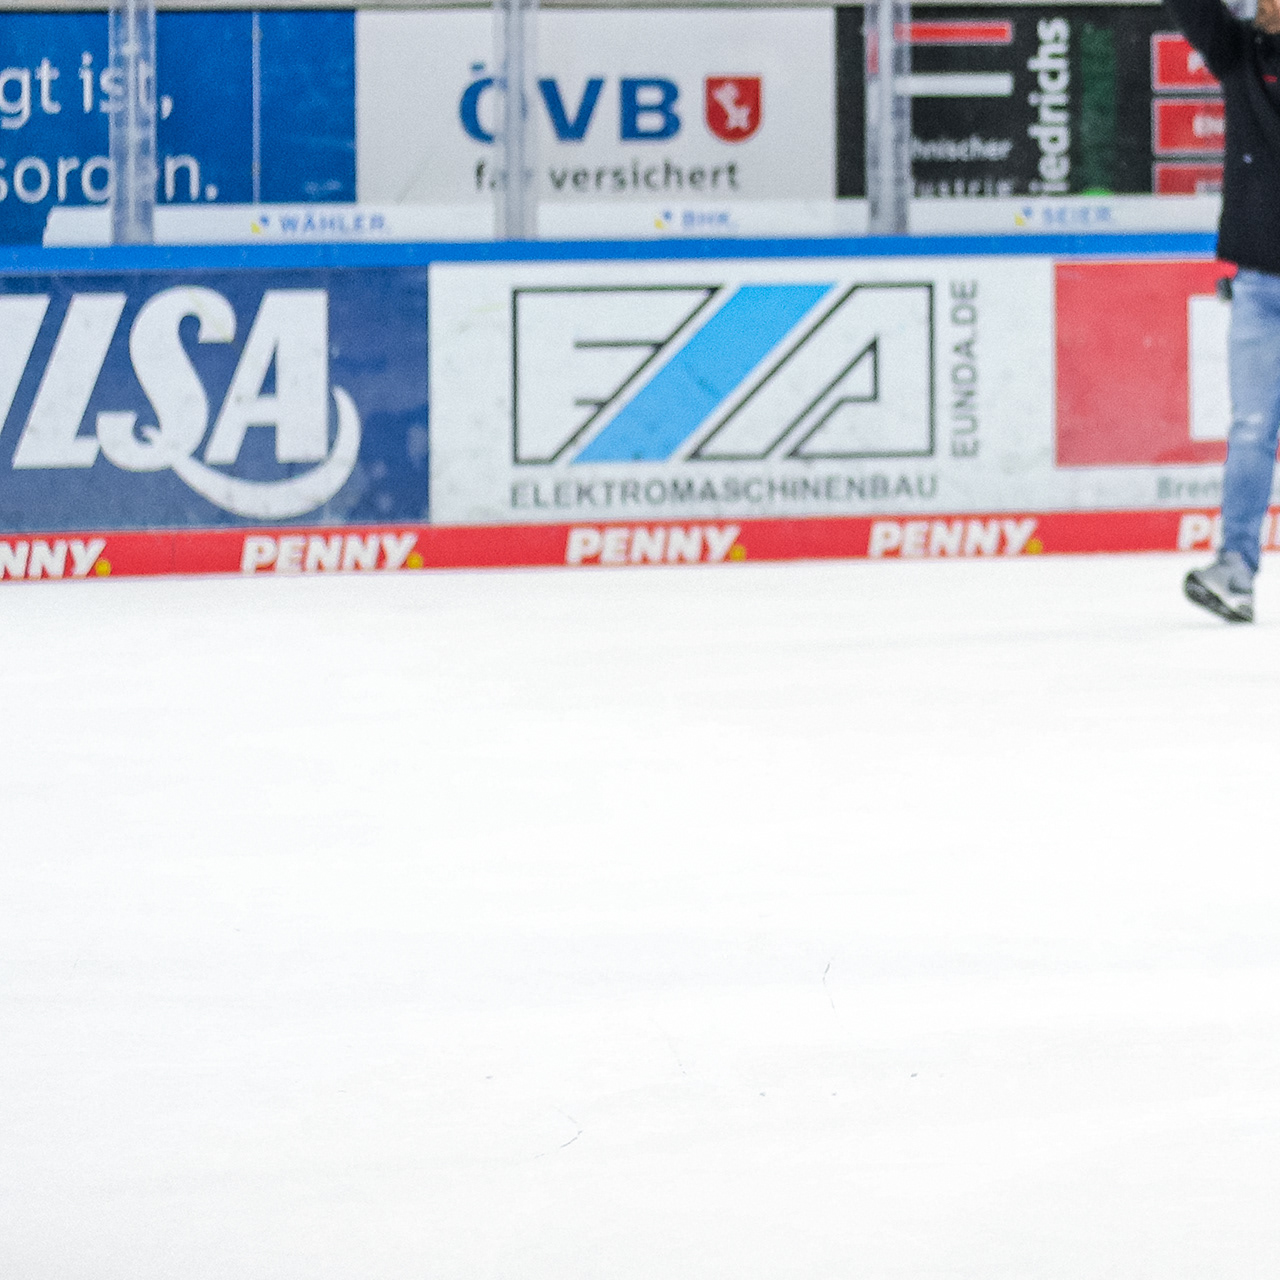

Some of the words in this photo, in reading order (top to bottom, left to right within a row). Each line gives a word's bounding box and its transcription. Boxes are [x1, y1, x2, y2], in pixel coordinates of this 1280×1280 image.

[459, 62, 682, 144] ÖVB
[1027, 18, 1071, 193] iedrichs
[549, 157, 740, 192] versichert
[510, 474, 939, 510] ELEKTROMASCHINENBAU
